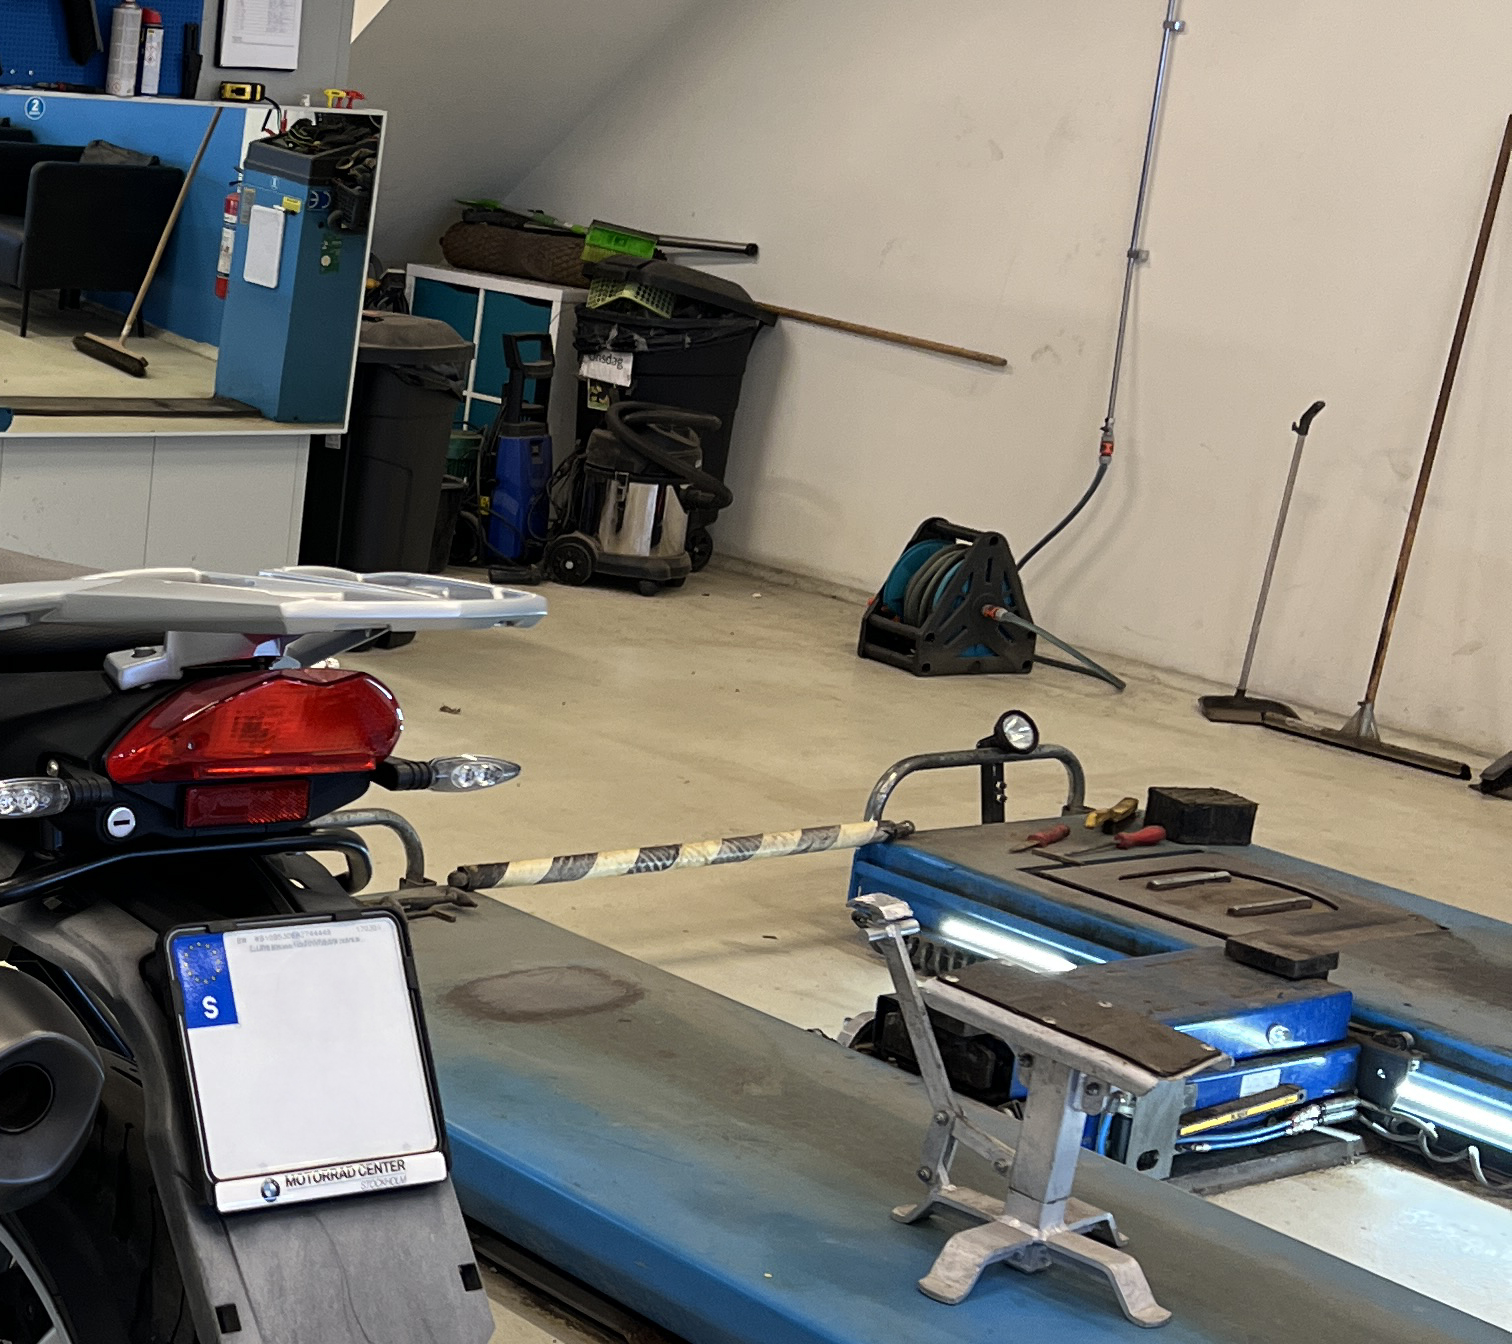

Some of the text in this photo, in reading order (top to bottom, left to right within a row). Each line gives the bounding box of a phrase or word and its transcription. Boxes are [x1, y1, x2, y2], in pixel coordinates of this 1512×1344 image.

[31, 99, 39, 112] 2
[201, 995, 220, 1020] S
[285, 1159, 406, 1188] MOTORRAD CENTER
